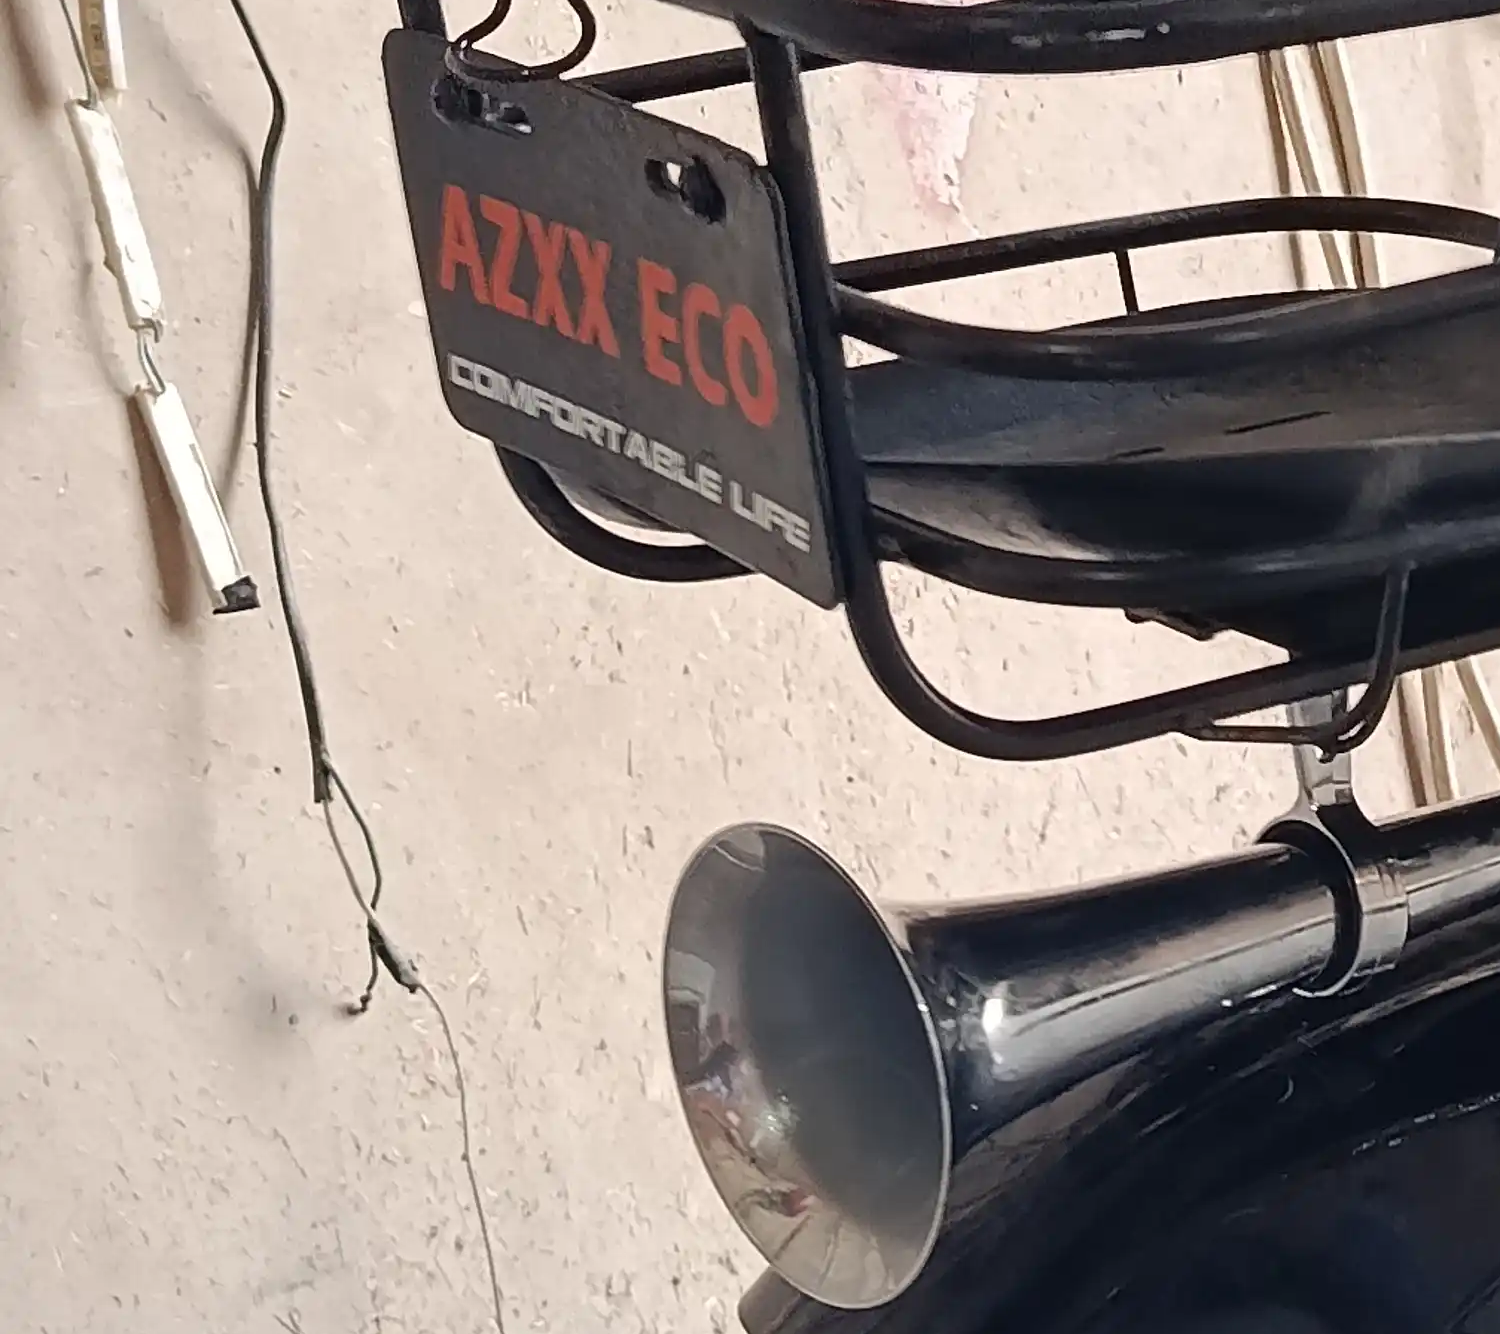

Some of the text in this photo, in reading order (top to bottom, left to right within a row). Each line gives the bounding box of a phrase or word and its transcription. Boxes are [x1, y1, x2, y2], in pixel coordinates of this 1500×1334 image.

[438, 183, 780, 428] AZXX ECO
[446, 351, 813, 554] COMFORTABLE LIFE
